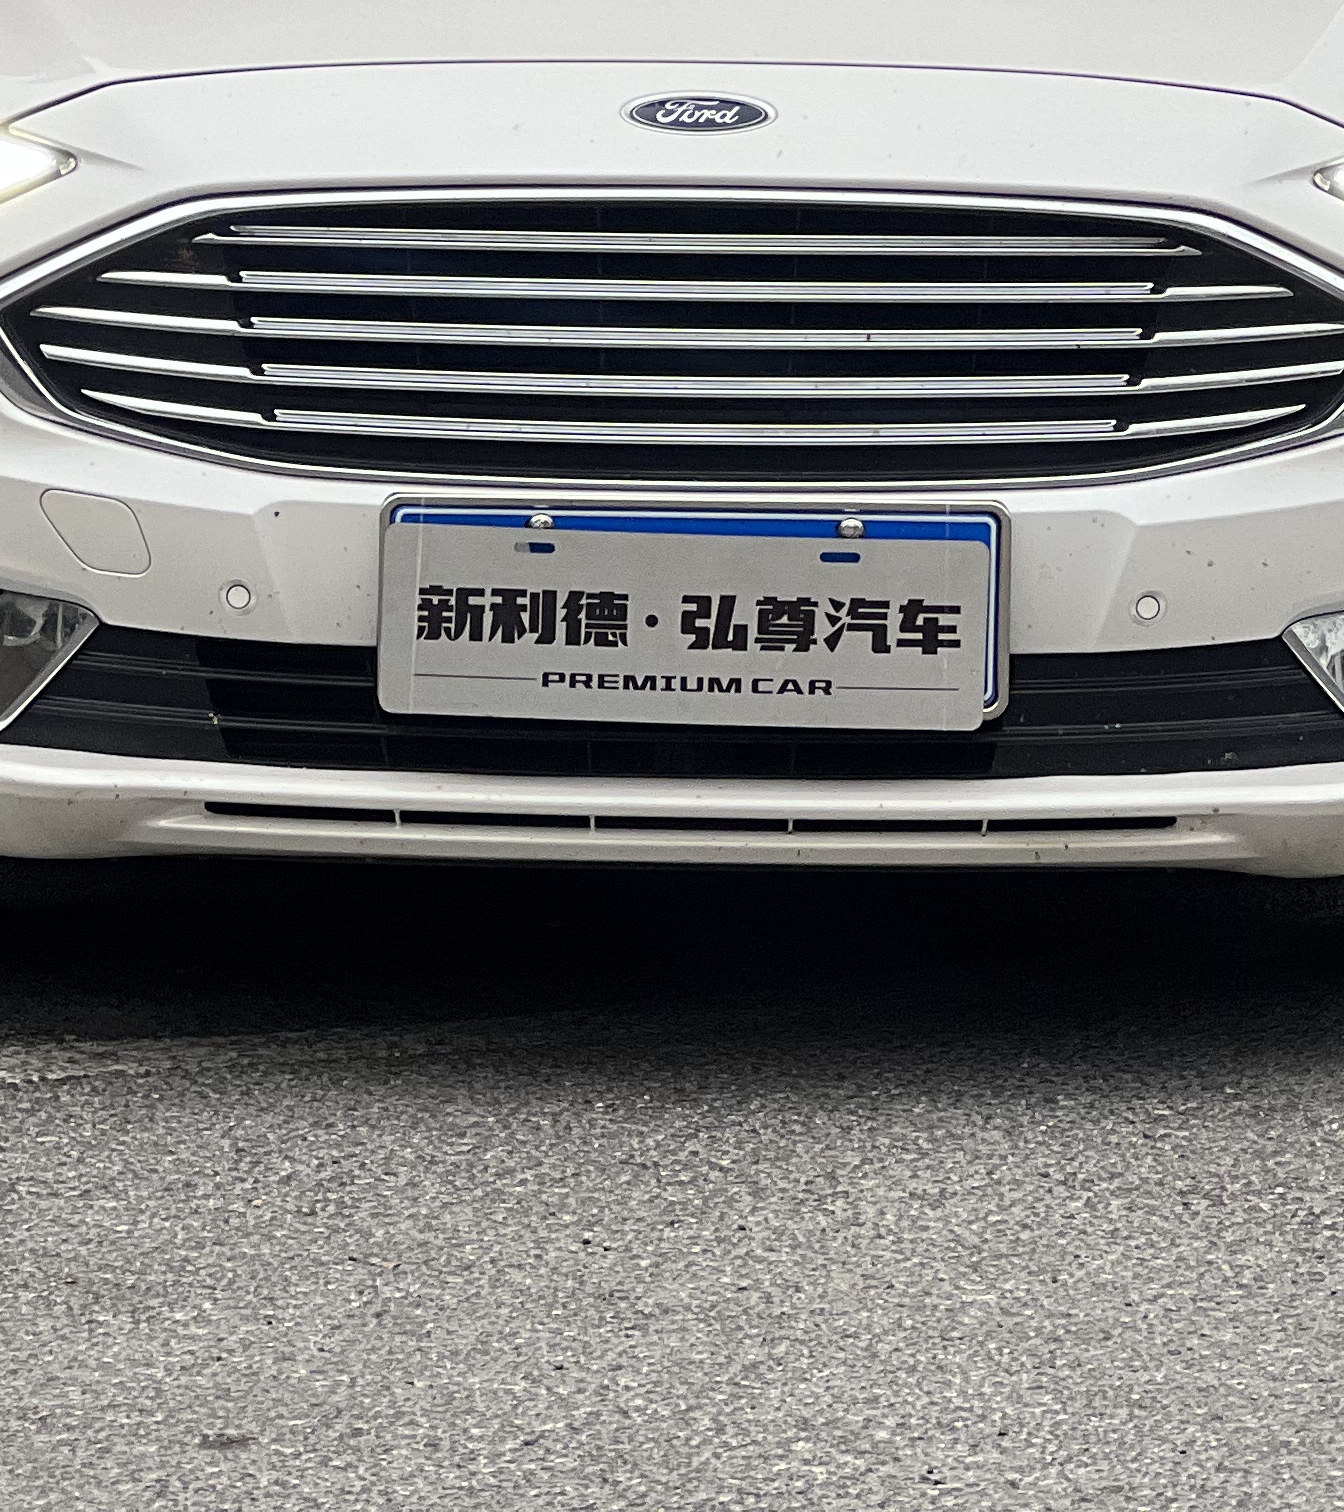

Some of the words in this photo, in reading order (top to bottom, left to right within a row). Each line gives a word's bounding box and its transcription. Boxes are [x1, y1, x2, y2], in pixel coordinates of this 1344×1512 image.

[655, 99, 740, 124] Ford
[416, 584, 961, 655] 新利德·弘尊汽车
[541, 671, 742, 694] PREMIUM
[751, 677, 833, 696] CAR
